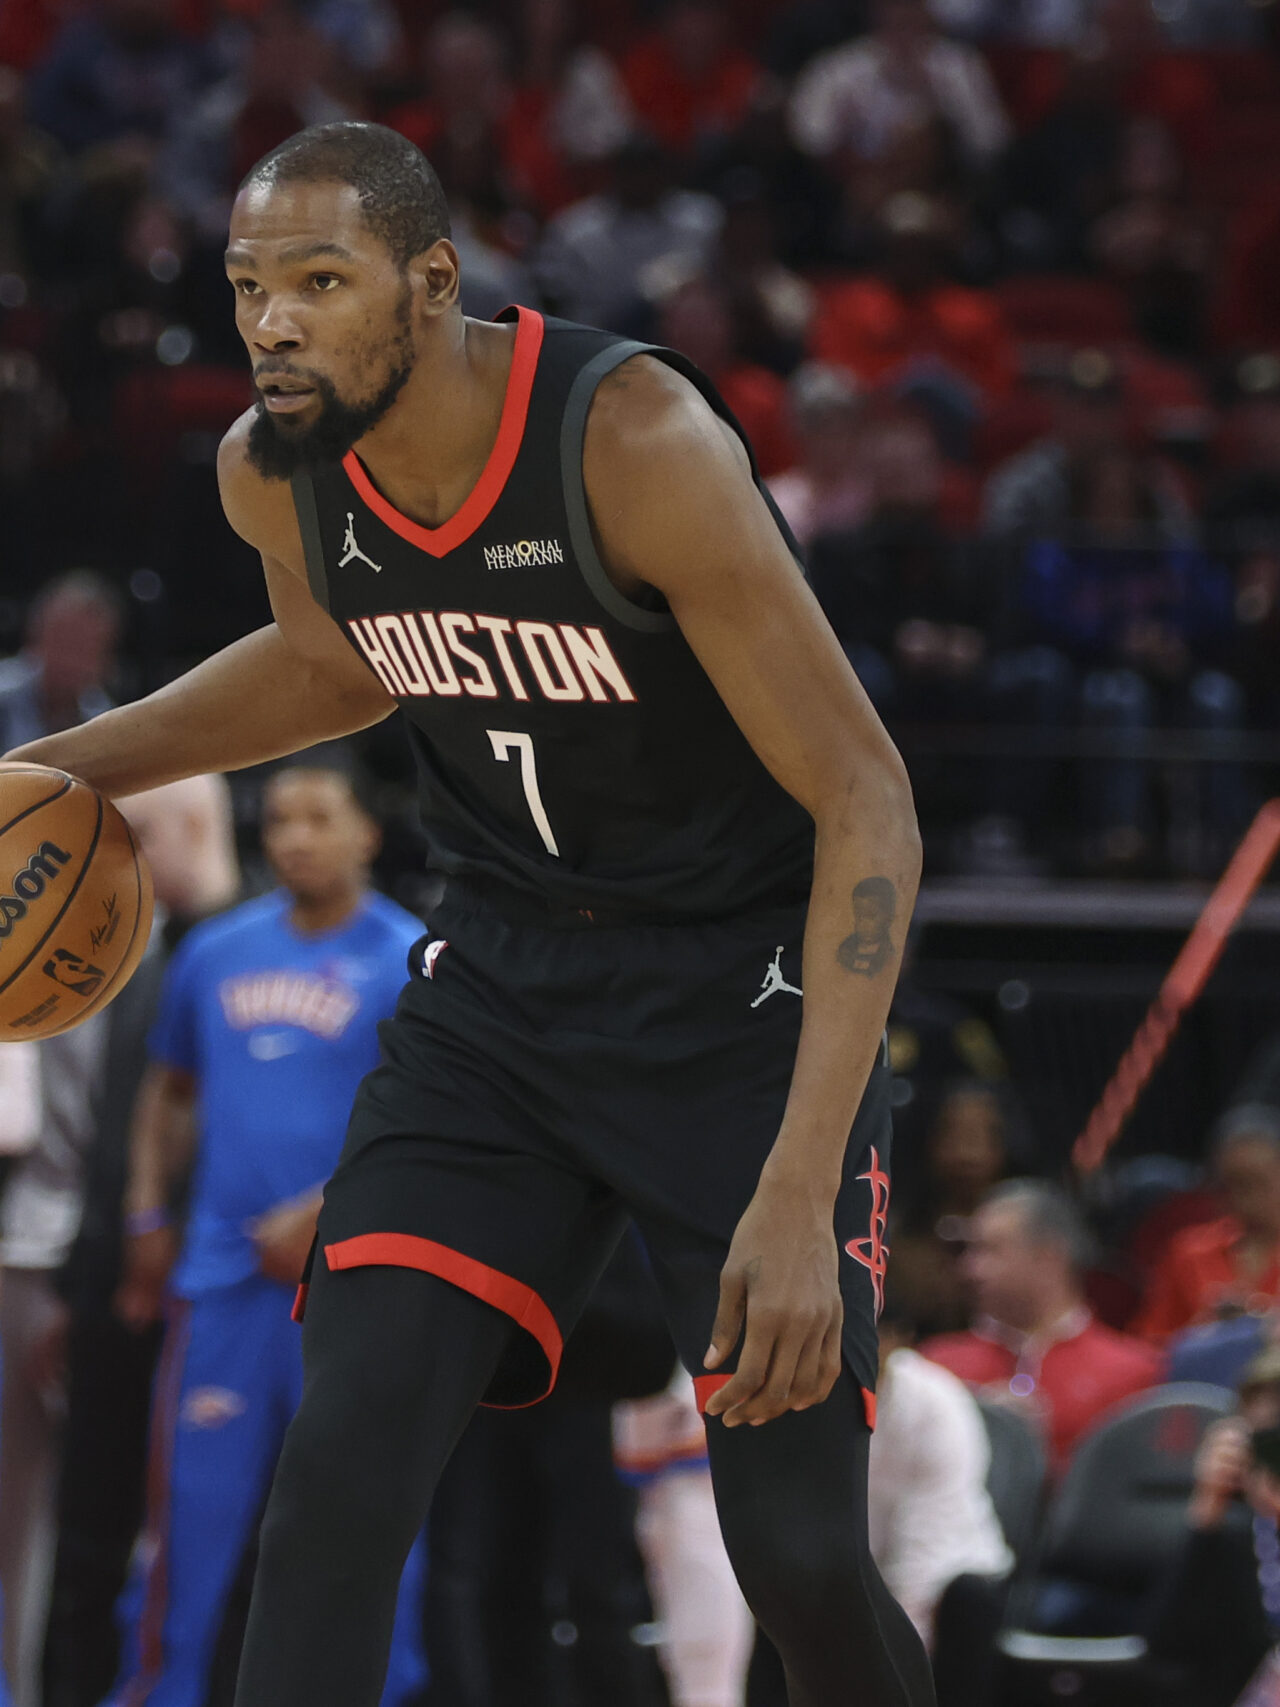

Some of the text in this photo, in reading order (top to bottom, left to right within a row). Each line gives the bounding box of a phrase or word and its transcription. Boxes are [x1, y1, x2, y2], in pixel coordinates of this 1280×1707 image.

[483, 539, 560, 559] MEMORIAL
[485, 549, 564, 570] HERMANN
[347, 610, 638, 702] HOUSTON
[486, 729, 560, 857] 7
